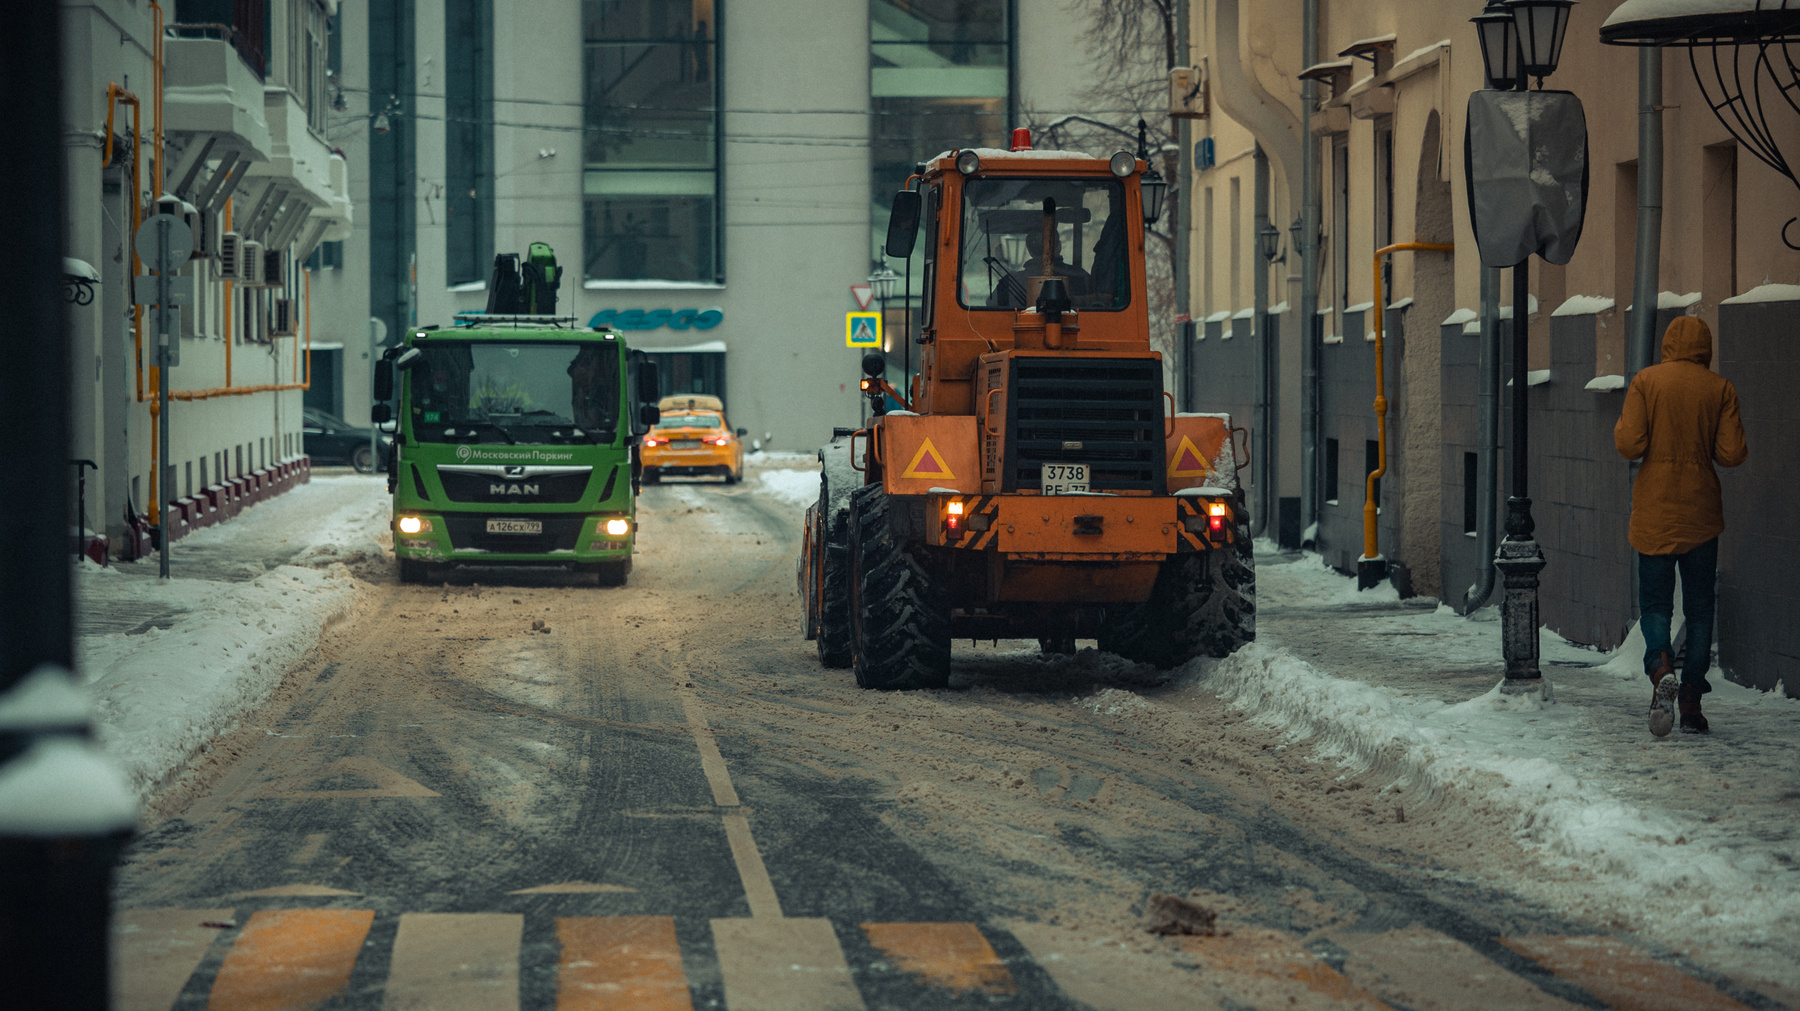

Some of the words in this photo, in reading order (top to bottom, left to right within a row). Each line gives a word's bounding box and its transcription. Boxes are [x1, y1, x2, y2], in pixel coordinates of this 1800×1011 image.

[587, 308, 724, 331] FESCO
[472, 450, 532, 460] Московский
[532, 450, 574, 462] Паркинг
[1047, 466, 1084, 480] 3738
[489, 484, 540, 495] MAN
